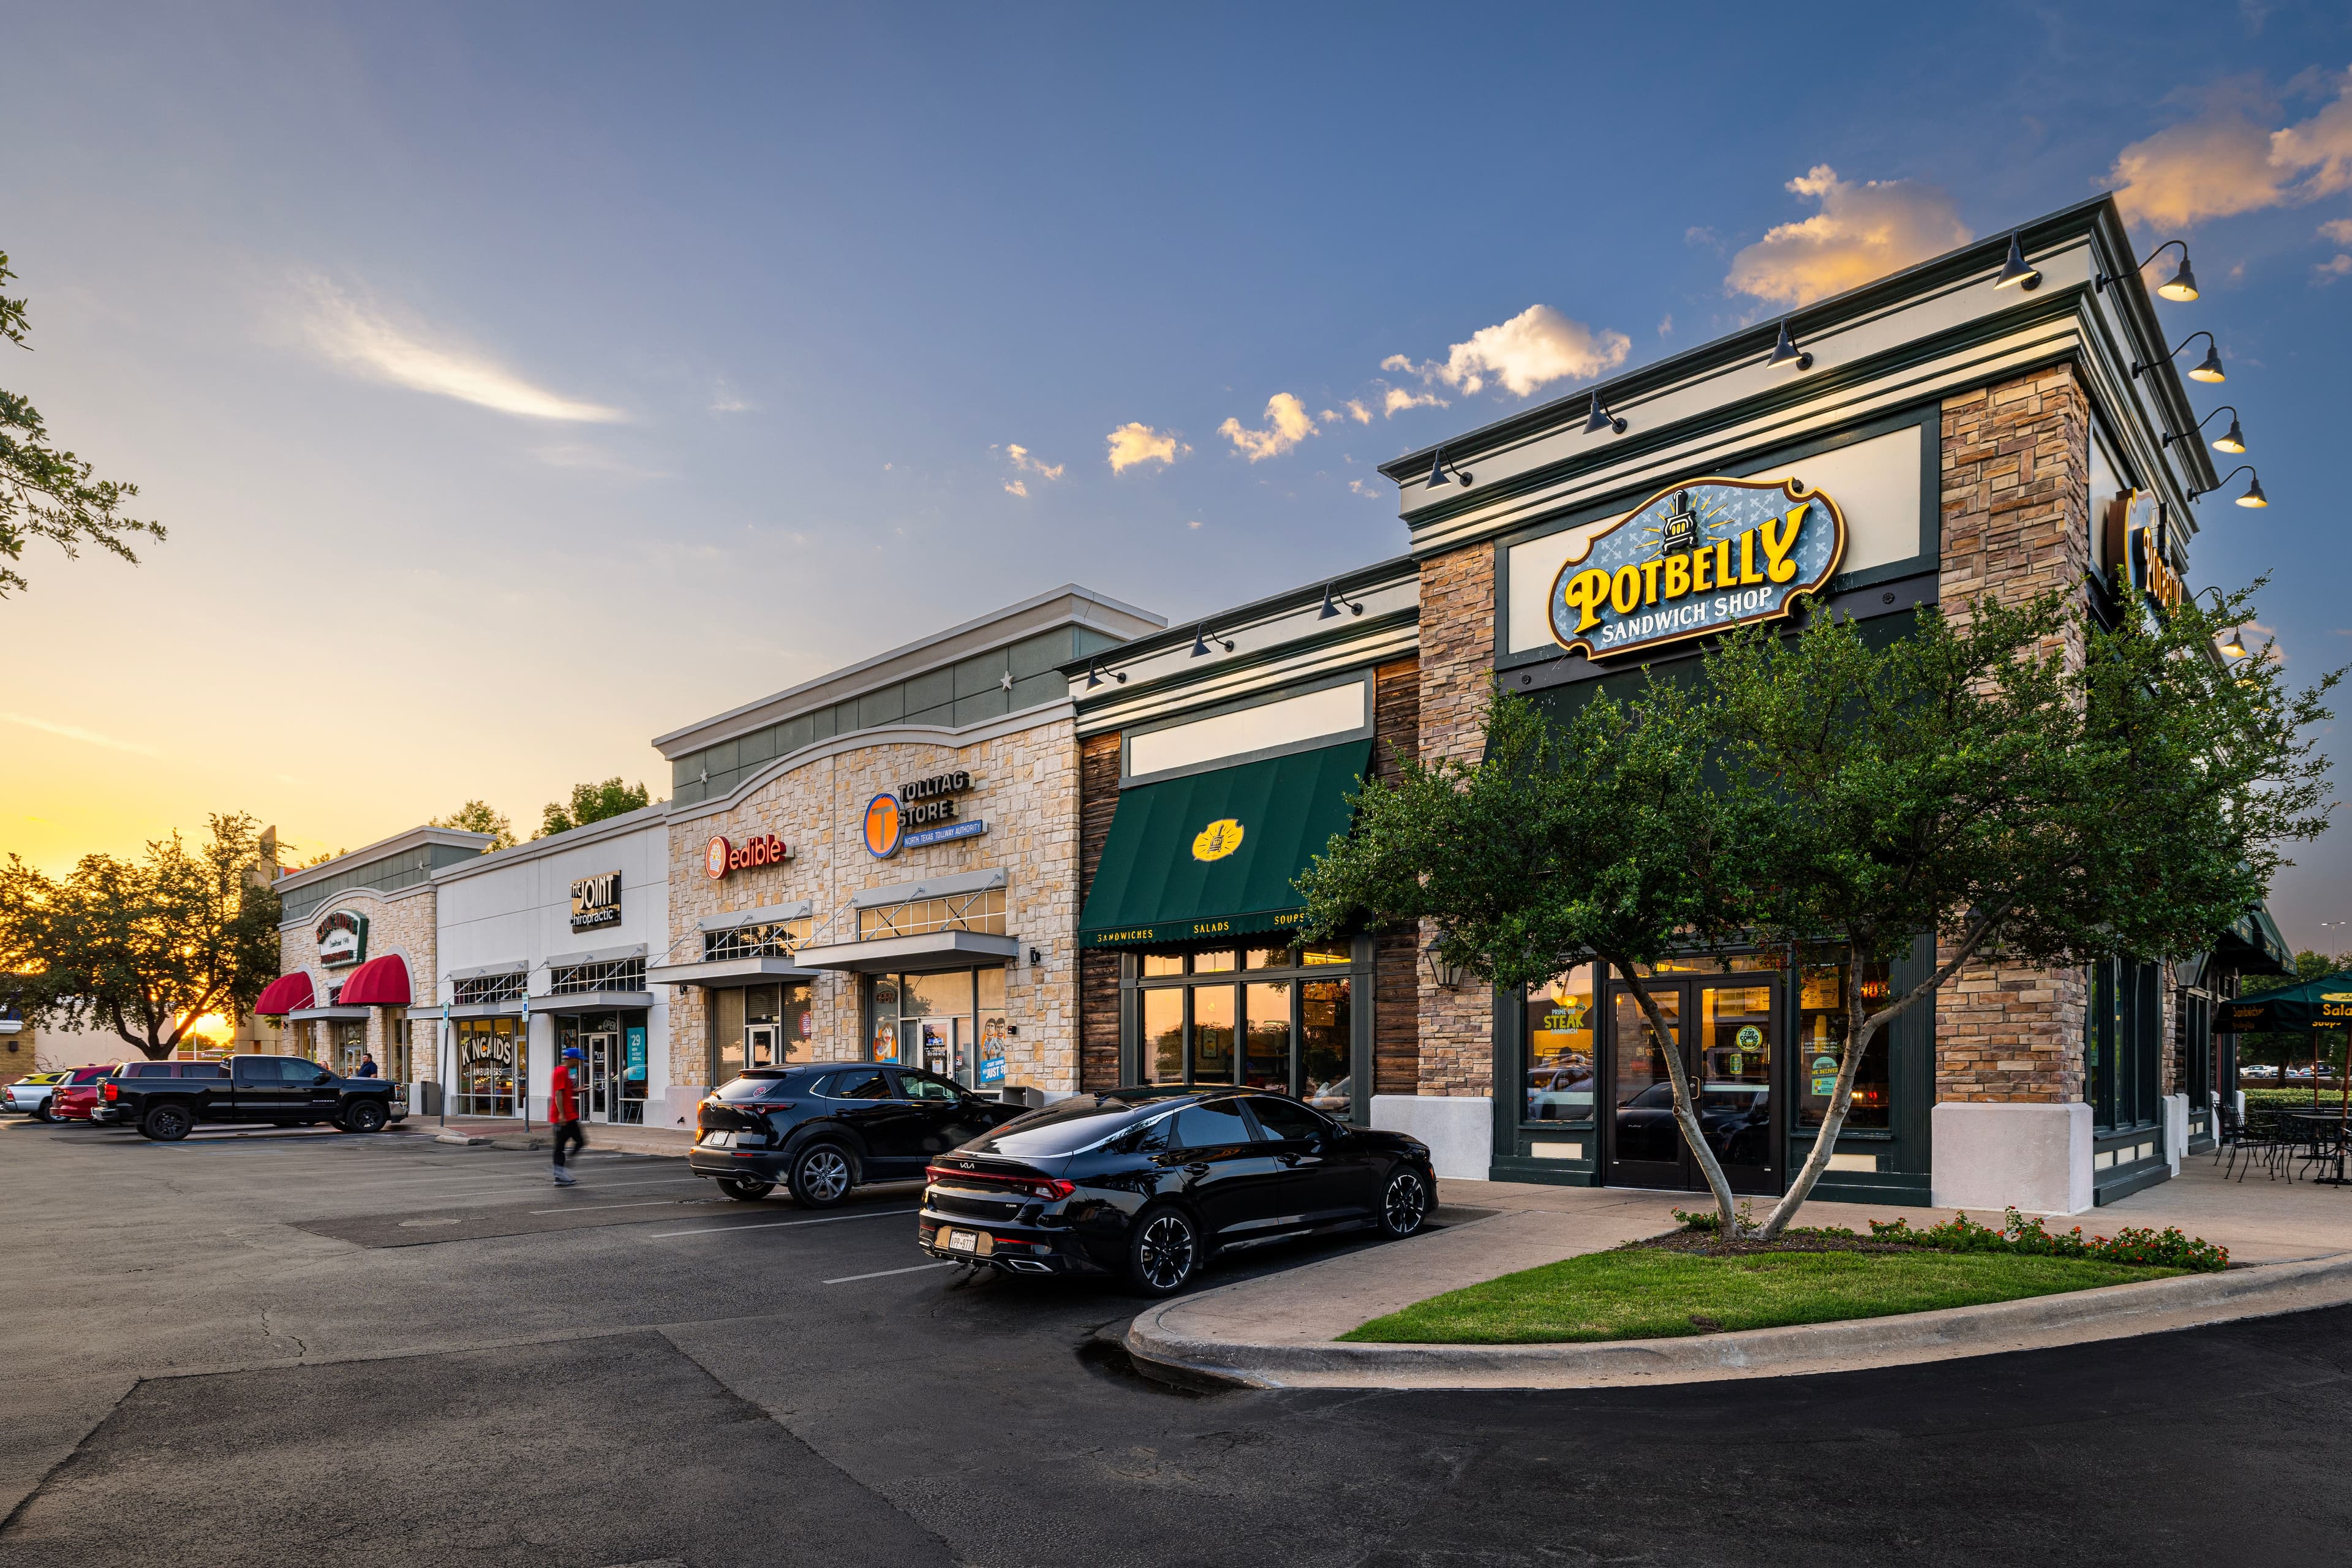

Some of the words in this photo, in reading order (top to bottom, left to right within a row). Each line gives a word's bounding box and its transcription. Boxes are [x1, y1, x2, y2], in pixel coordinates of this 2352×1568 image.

[1564, 502, 1812, 636] POTBELLY
[1602, 601, 1706, 643] SANDWICH
[1714, 586, 1773, 617] SHOP
[898, 770, 965, 802] TOLLTAG
[897, 799, 951, 827] STORE
[905, 835, 919, 845] NORTH
[921, 832, 933, 843] TEXAS
[935, 829, 954, 840] TOLLWAY
[955, 823, 981, 835] AUTHORITY
[729, 833, 781, 870] edible
[570, 882, 581, 897] THE
[579, 874, 614, 910] JOINT
[570, 907, 613, 926] chiropractic
[1194, 921, 1230, 933] SALADS
[1274, 913, 1305, 925] SOUPS
[1097, 930, 1153, 942] SANDWICHES
[603, 1019, 618, 1030] OPEN
[1544, 1014, 1585, 1029] STEAK
[461, 1035, 511, 1065] KNCAID'S
[986, 1066, 1000, 1079] JUST
